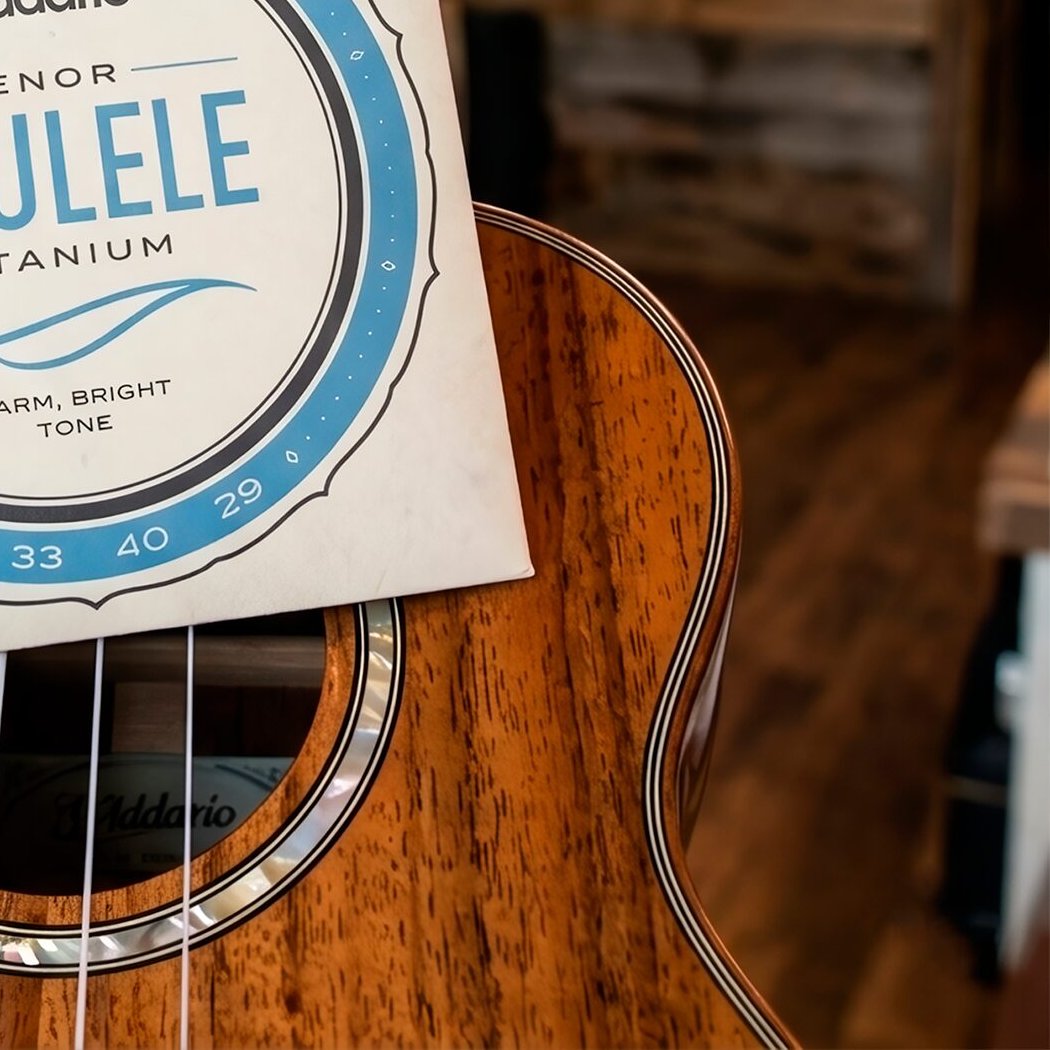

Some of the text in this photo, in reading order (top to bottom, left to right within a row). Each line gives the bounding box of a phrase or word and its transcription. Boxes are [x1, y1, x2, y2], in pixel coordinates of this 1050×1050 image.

[71, 379, 172, 406] BRIGHT
[36, 414, 113, 438] TONE
[12, 544, 62, 569] 33
[116, 526, 169, 556] 40
[214, 478, 263, 519] 29
